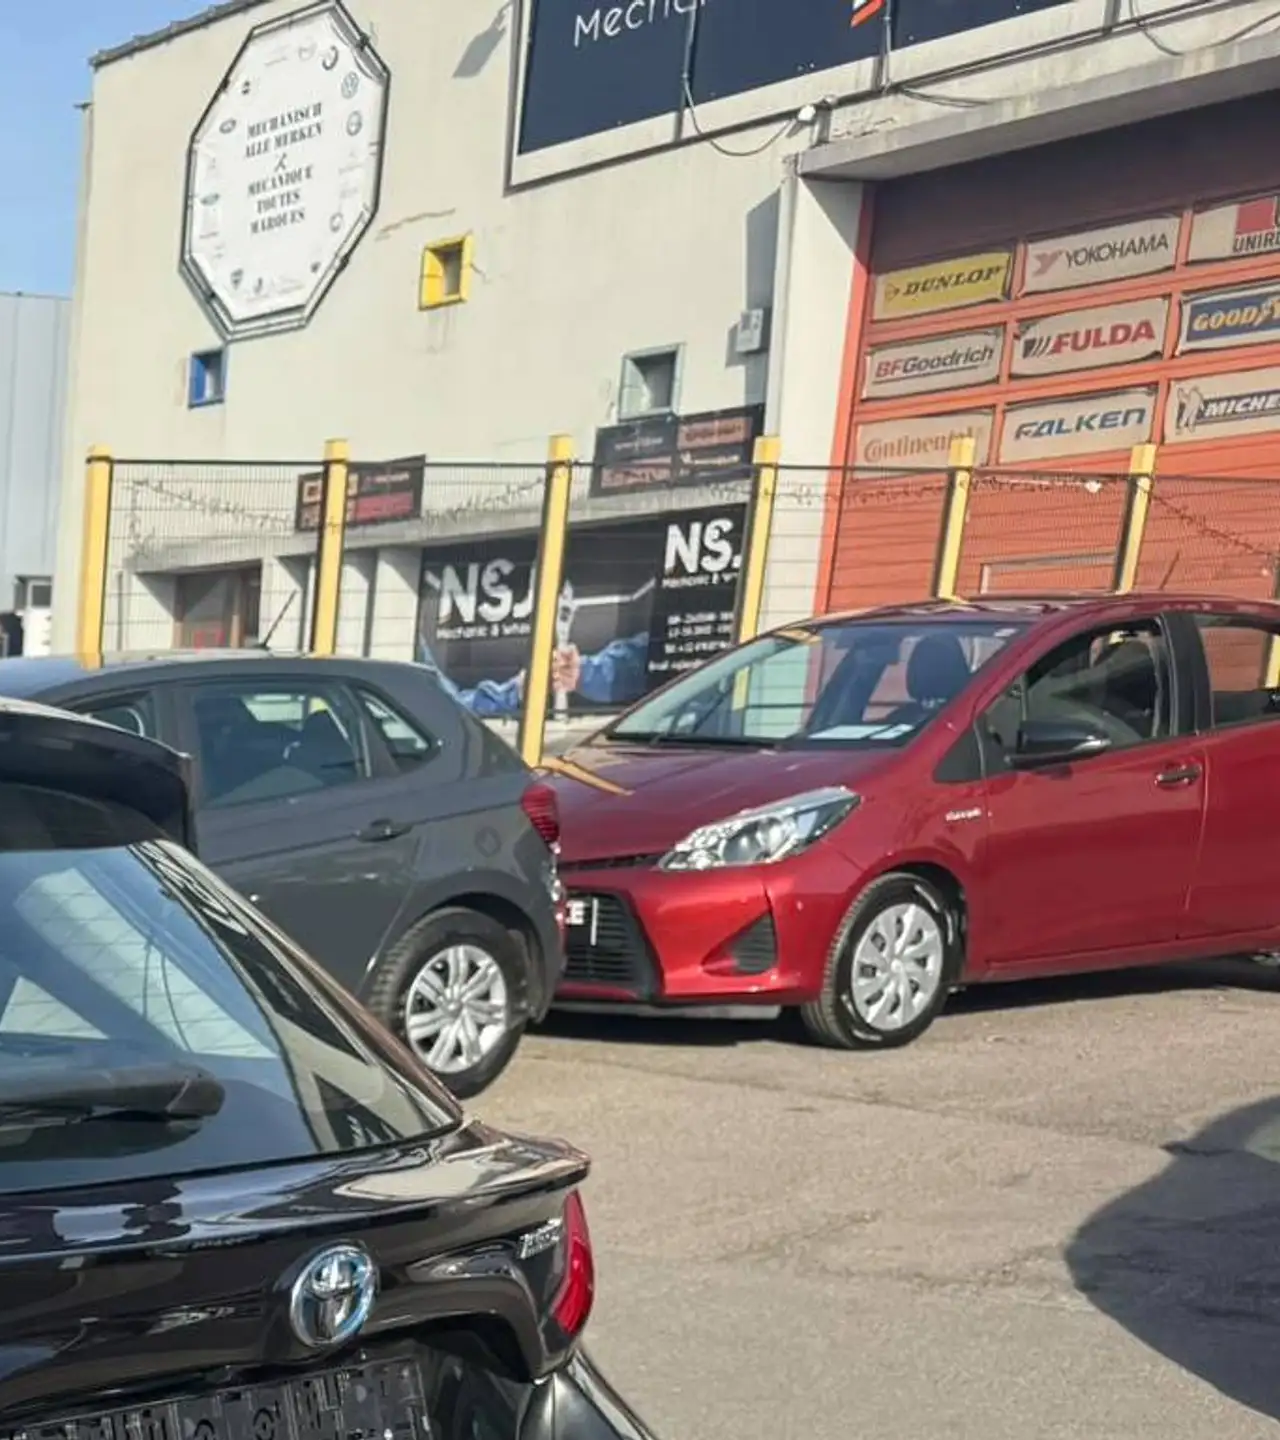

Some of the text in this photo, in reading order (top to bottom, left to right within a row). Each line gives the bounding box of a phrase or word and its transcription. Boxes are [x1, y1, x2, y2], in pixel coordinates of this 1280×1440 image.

[246, 140, 270, 158] ALLE
[1065, 232, 1169, 269] YOKOHAMA
[902, 264, 1005, 297] DUNLOP
[1048, 319, 1156, 355] FULDA
[874, 344, 994, 379] BFGoodrich
[1013, 407, 1147, 442] FALKEN
